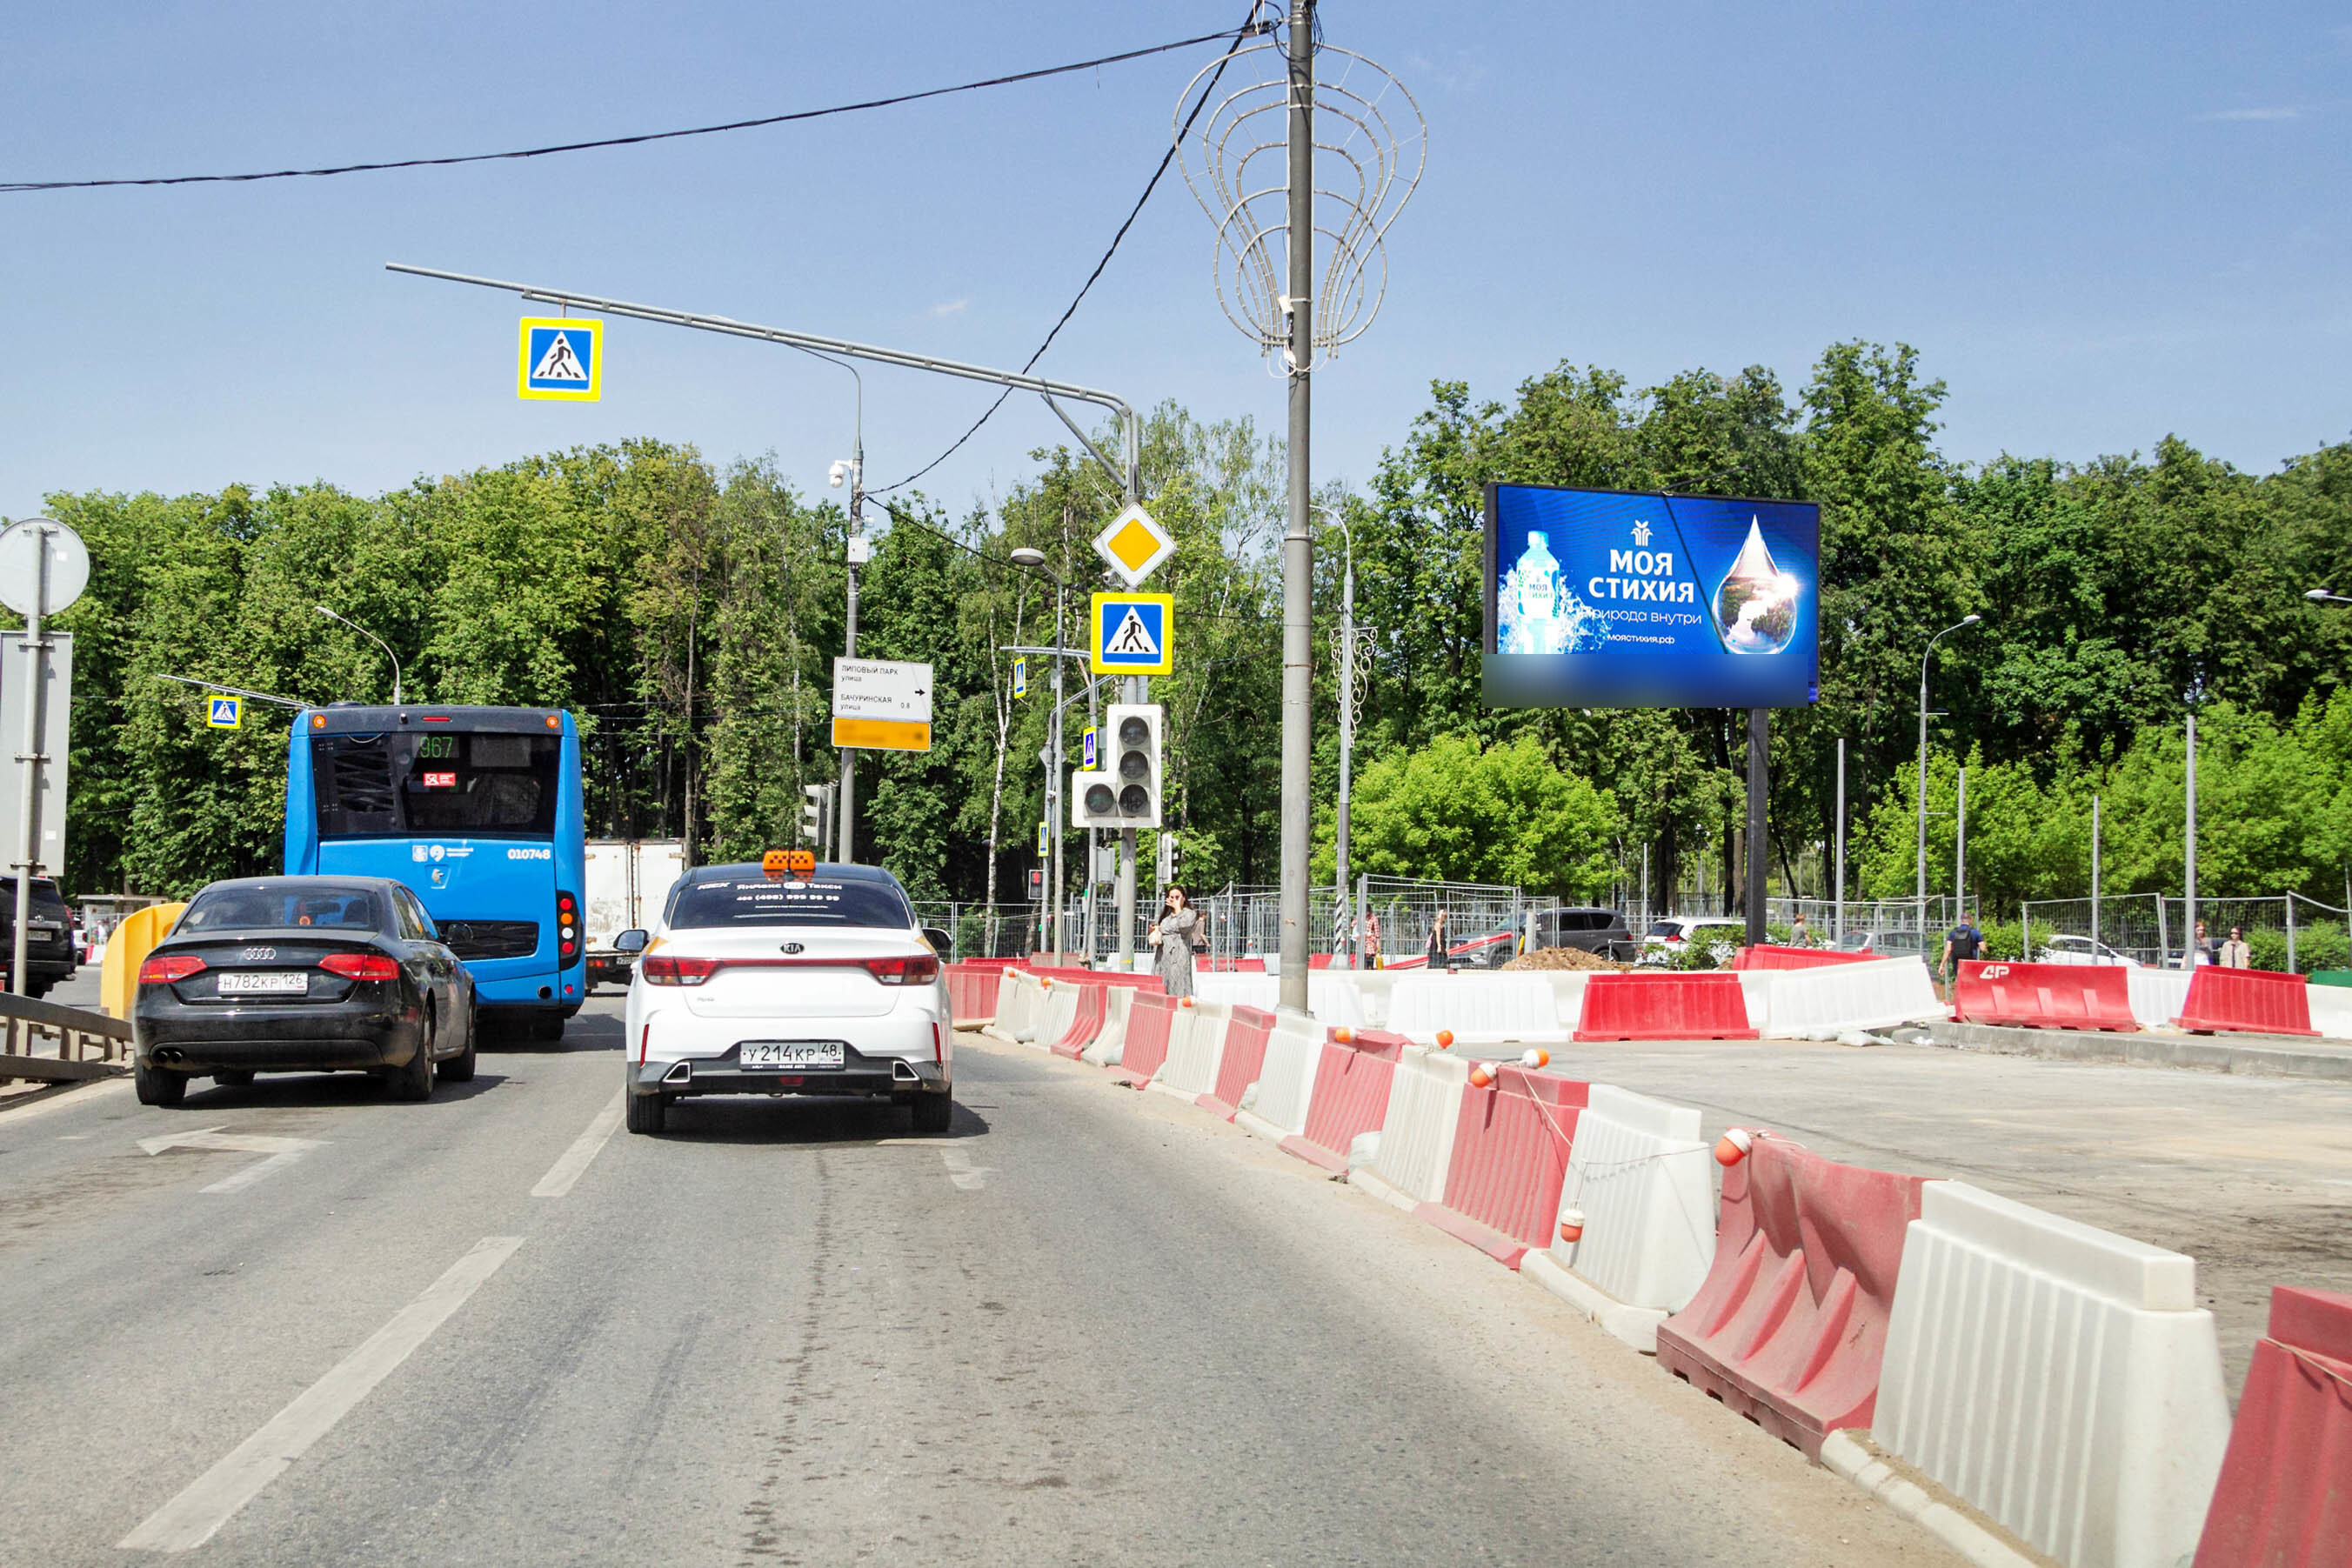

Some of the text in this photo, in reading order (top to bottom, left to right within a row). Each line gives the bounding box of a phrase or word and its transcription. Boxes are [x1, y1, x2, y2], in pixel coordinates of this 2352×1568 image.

[1609, 549, 1673, 576] МОЯ
[1588, 577, 1694, 603] СТИХИЯ
[1651, 611, 1702, 625] внутри
[841, 664, 878, 675] ЛИПОВЫЙ
[840, 693, 892, 704] БАЧУРИНСКАЯ
[419, 736, 453, 758] 967
[507, 849, 551, 860] 010748
[282, 973, 303, 984] 126
[821, 1044, 837, 1057] 48
